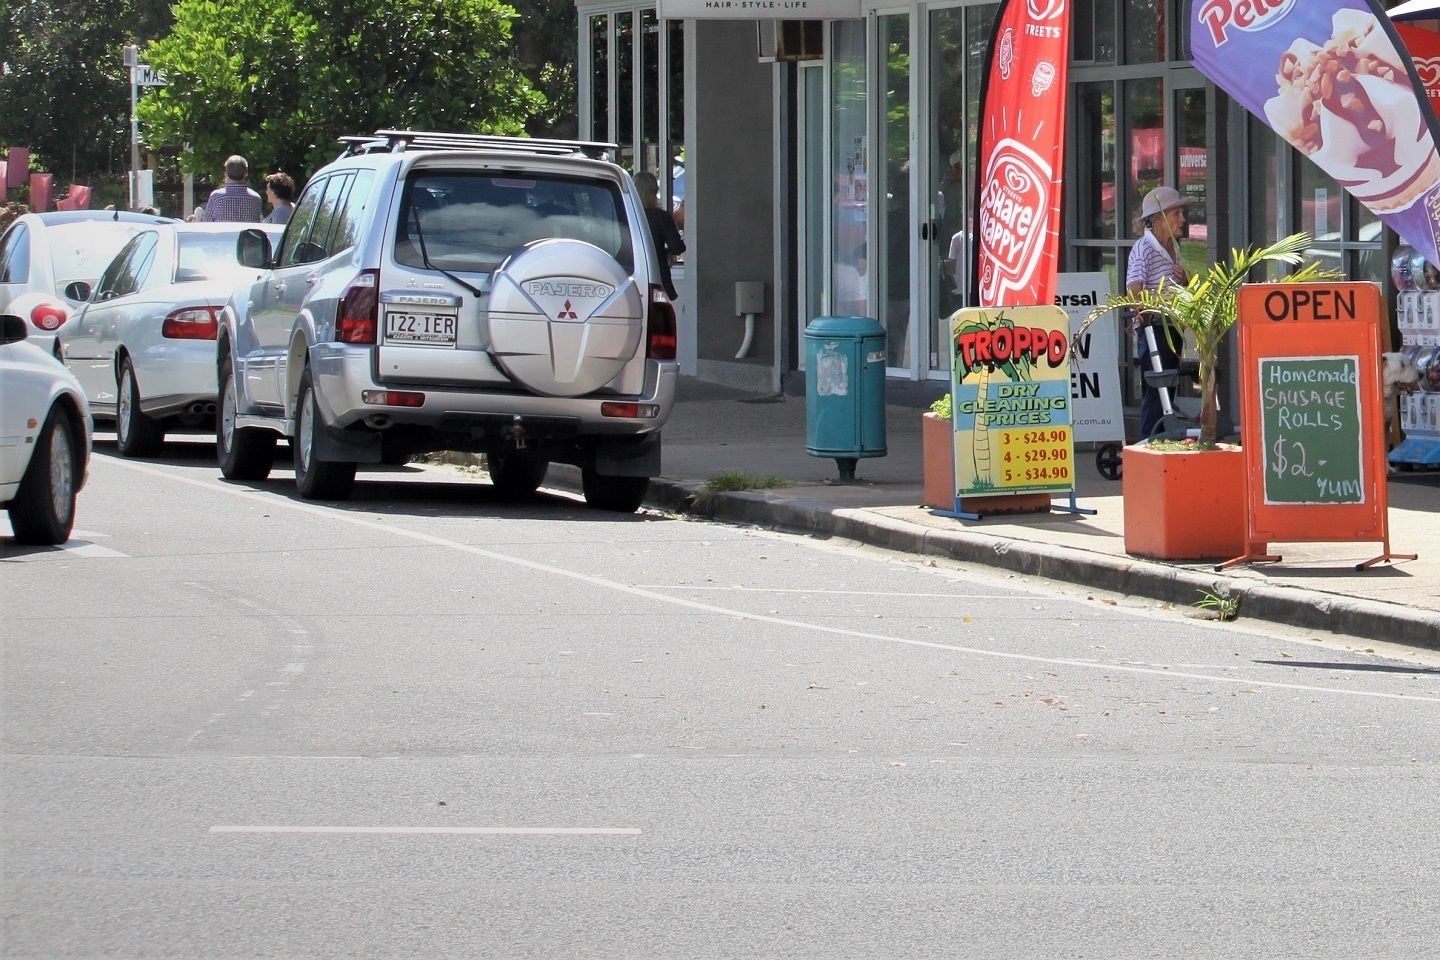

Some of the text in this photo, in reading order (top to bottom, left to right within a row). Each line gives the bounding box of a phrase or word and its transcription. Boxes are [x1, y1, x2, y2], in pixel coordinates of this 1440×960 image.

[1025, 23, 1061, 38] TREETS
[529, 281, 611, 299] PAJERO
[399, 296, 447, 304] PAJERO
[1055, 291, 1098, 307] ersal
[1264, 290, 1356, 321] OPEN
[959, 327, 1068, 369] TROPPO
[1270, 363, 1357, 384] Homemade
[998, 383, 1041, 398] DRY
[1265, 388, 1345, 409] SAUSAGE
[959, 396, 1067, 415] CLEANING
[984, 411, 1052, 427] PRICES
[1003, 433, 1010, 444] 3
[1023, 431, 1066, 444] $24.90
[1004, 451, 1012, 463] 4
[1024, 449, 1067, 462] $29.90
[1005, 470, 1012, 481] 5
[1025, 467, 1068, 480] $34.90
